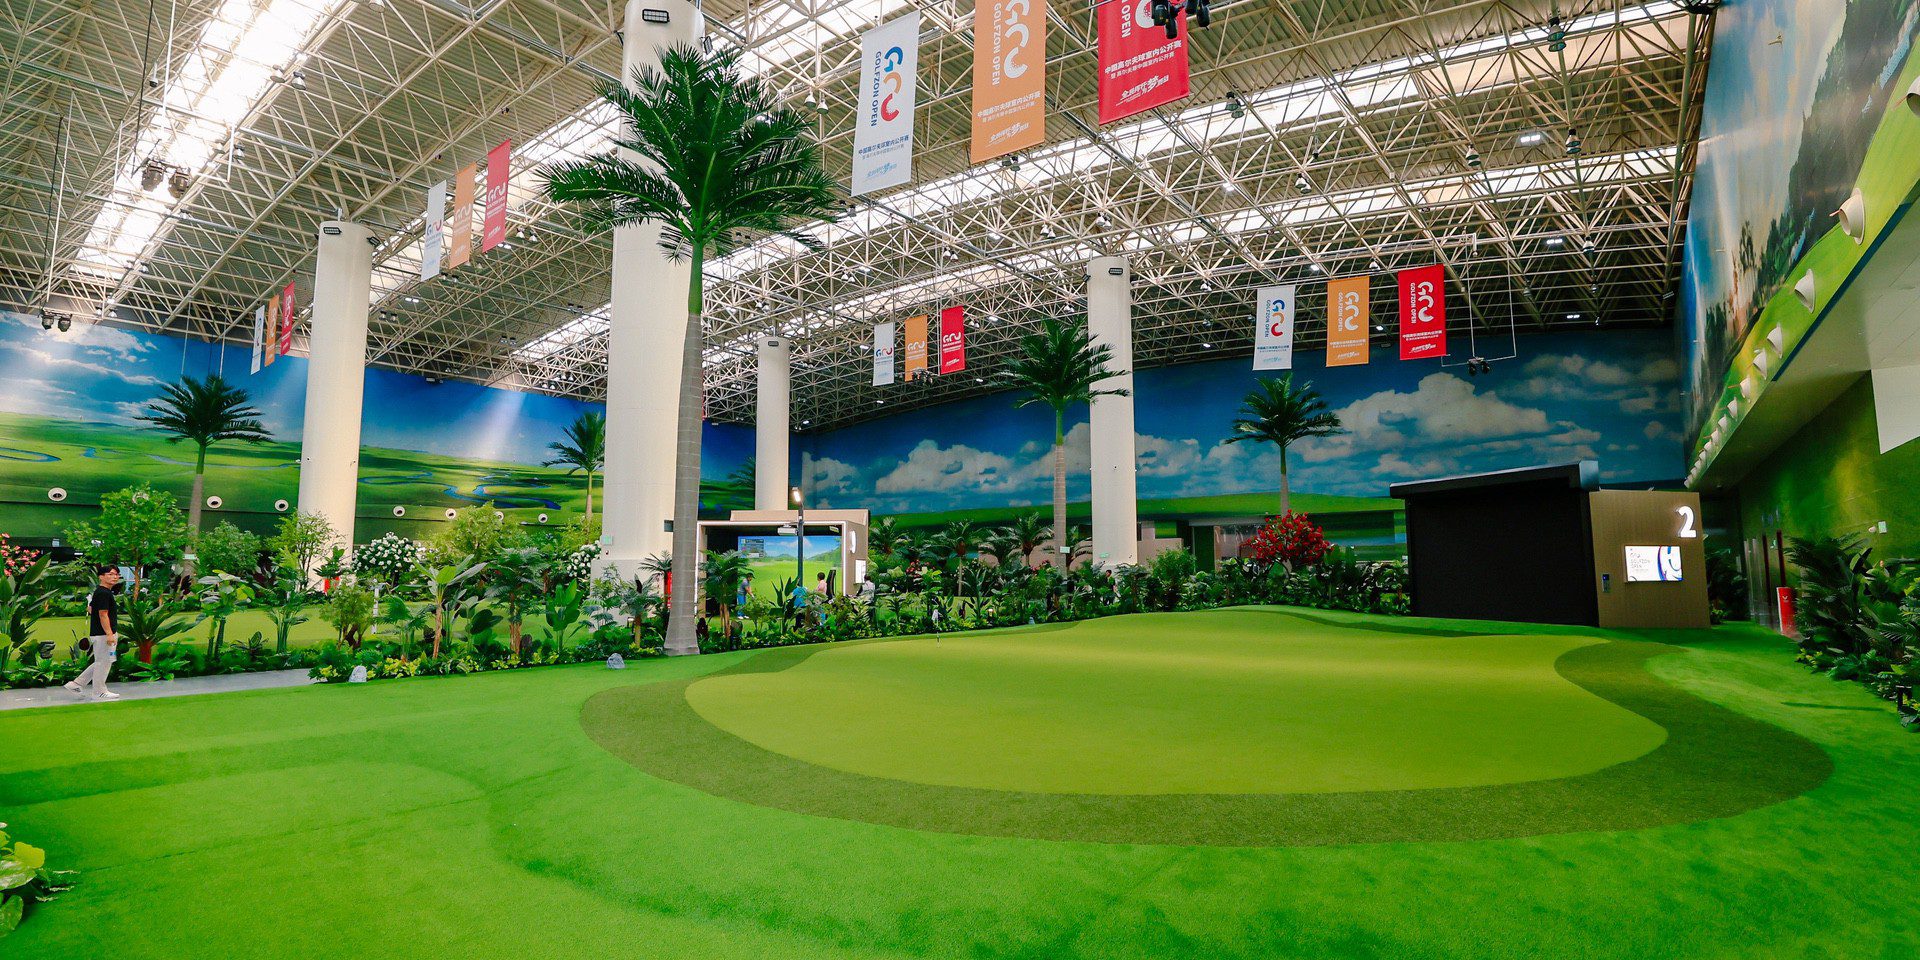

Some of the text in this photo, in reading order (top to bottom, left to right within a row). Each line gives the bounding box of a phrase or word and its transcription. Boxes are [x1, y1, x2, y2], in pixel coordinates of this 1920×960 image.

[1122, 5, 1131, 38] OPEN
[992, 2, 1002, 86] GOLFZON OPEN
[872, 51, 882, 100] GOLFZON
[1678, 505, 1697, 538] 2
